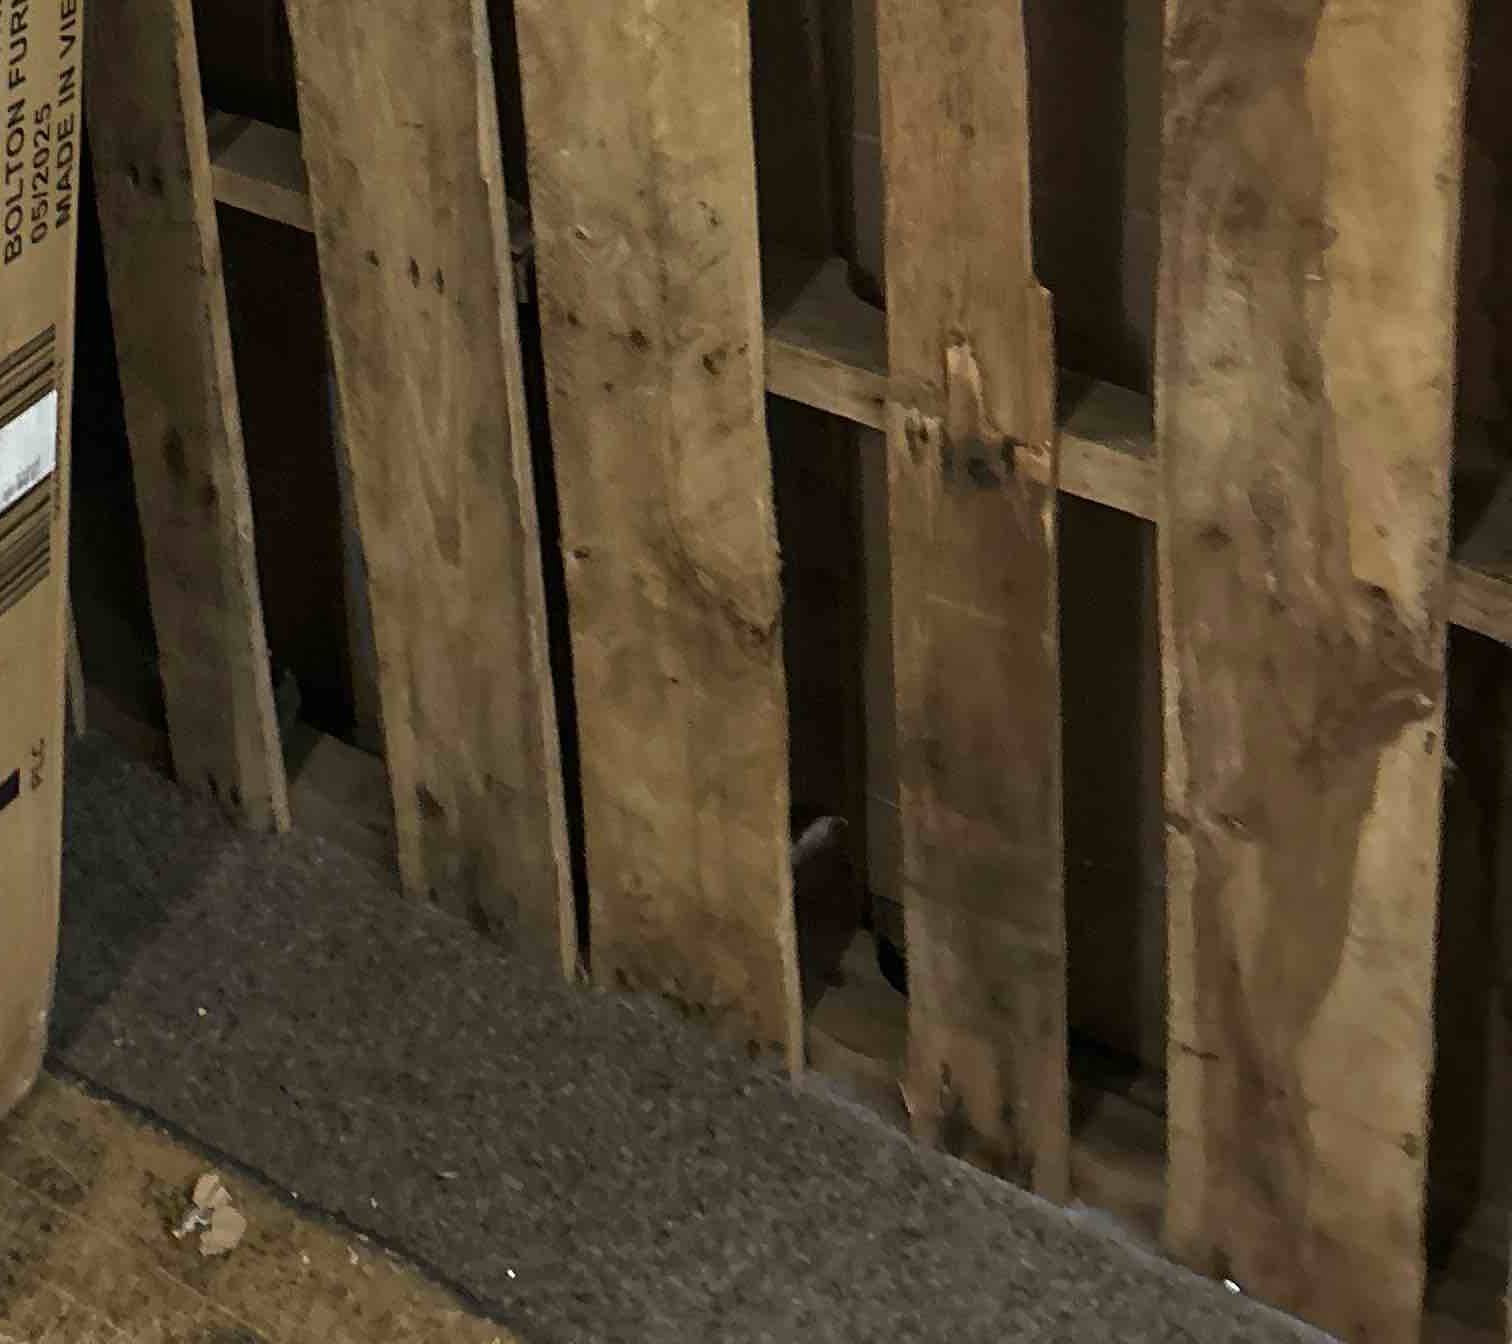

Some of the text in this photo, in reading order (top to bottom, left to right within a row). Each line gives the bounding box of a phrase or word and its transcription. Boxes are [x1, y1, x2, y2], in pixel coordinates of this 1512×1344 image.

[56, 66, 77, 102] IN
[5, 97, 29, 265] BOLTON
[30, 102, 53, 244] 05/2025
[55, 113, 76, 229] MADE
